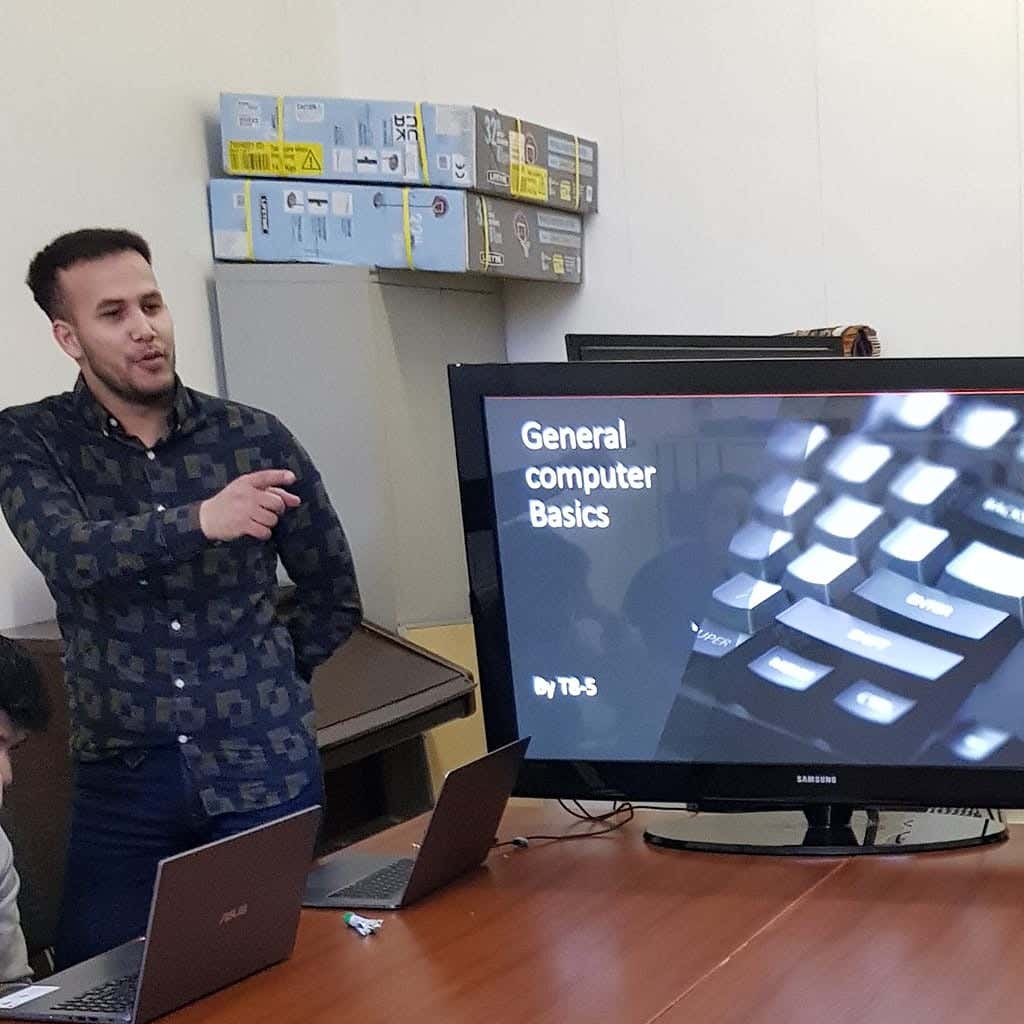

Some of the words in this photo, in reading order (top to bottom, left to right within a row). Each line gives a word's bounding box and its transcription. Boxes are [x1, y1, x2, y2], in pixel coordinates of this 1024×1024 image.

[521, 417, 627, 450] General
[525, 461, 656, 495] computer
[529, 499, 610, 528] Basics
[694, 628, 731, 647] UPER
[533, 676, 556, 699] By
[796, 775, 837, 784] SAMSUNG
